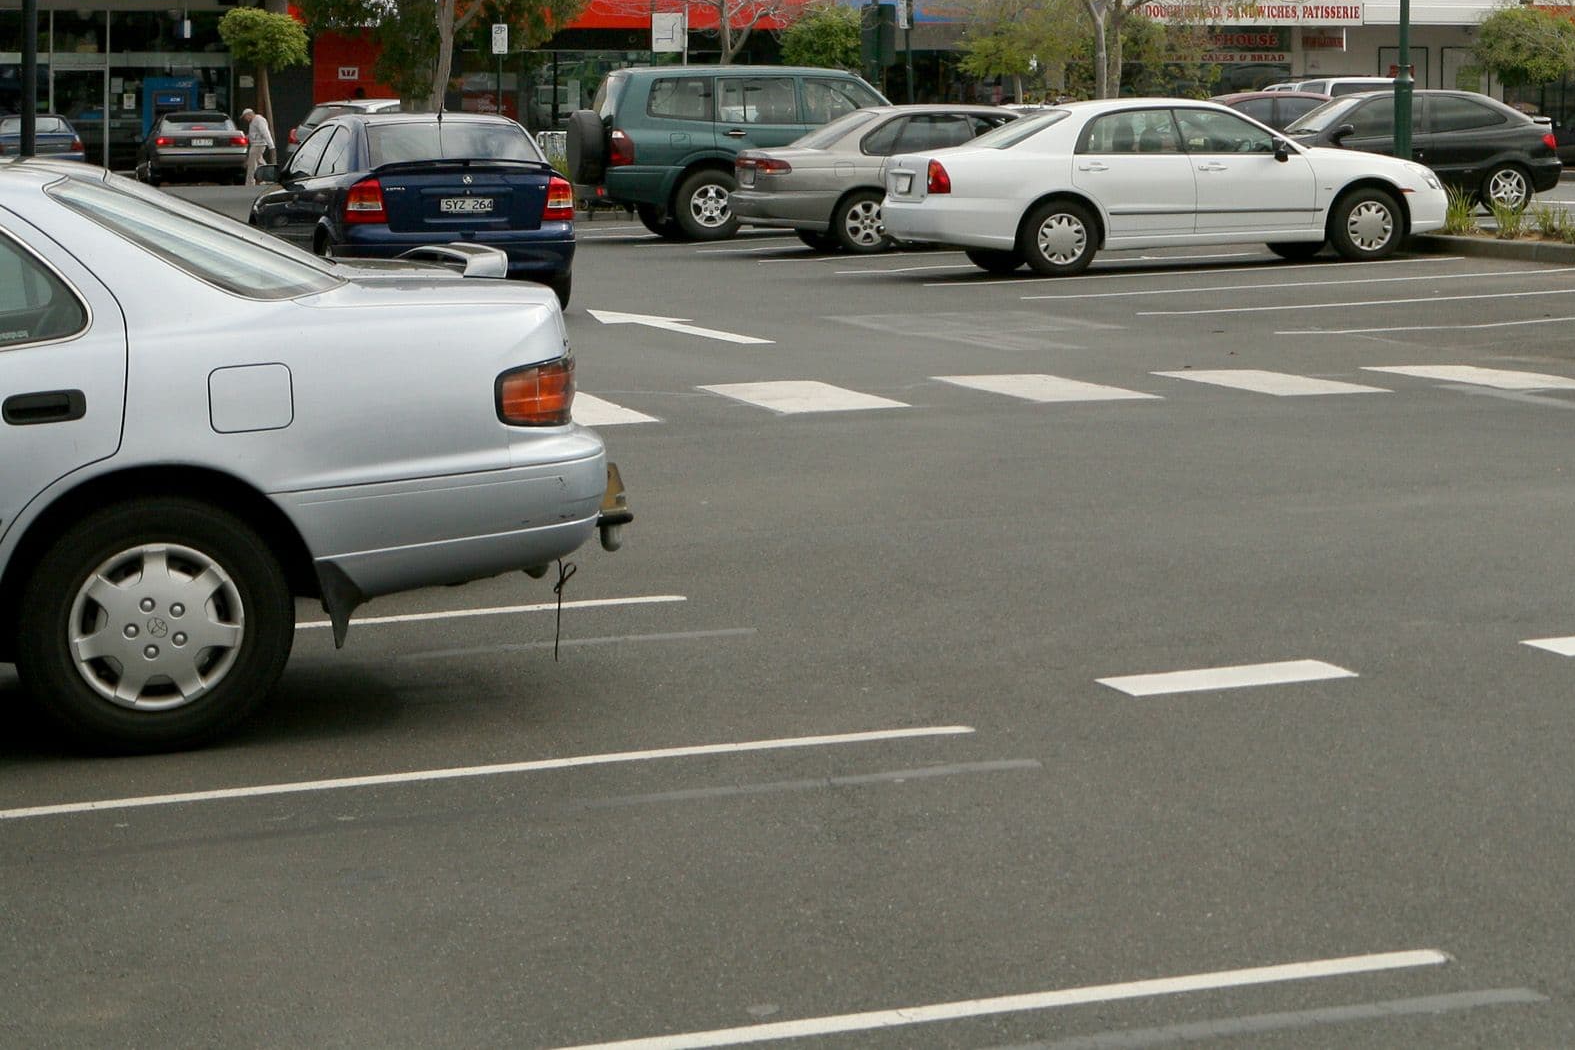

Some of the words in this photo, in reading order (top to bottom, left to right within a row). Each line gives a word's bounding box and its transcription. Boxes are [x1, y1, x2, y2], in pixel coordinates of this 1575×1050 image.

[1302, 6, 1360, 19] PATISSERIE
[1250, 54, 1285, 62] BREAD
[445, 200, 465, 210] SYZ
[472, 200, 493, 210] 264
